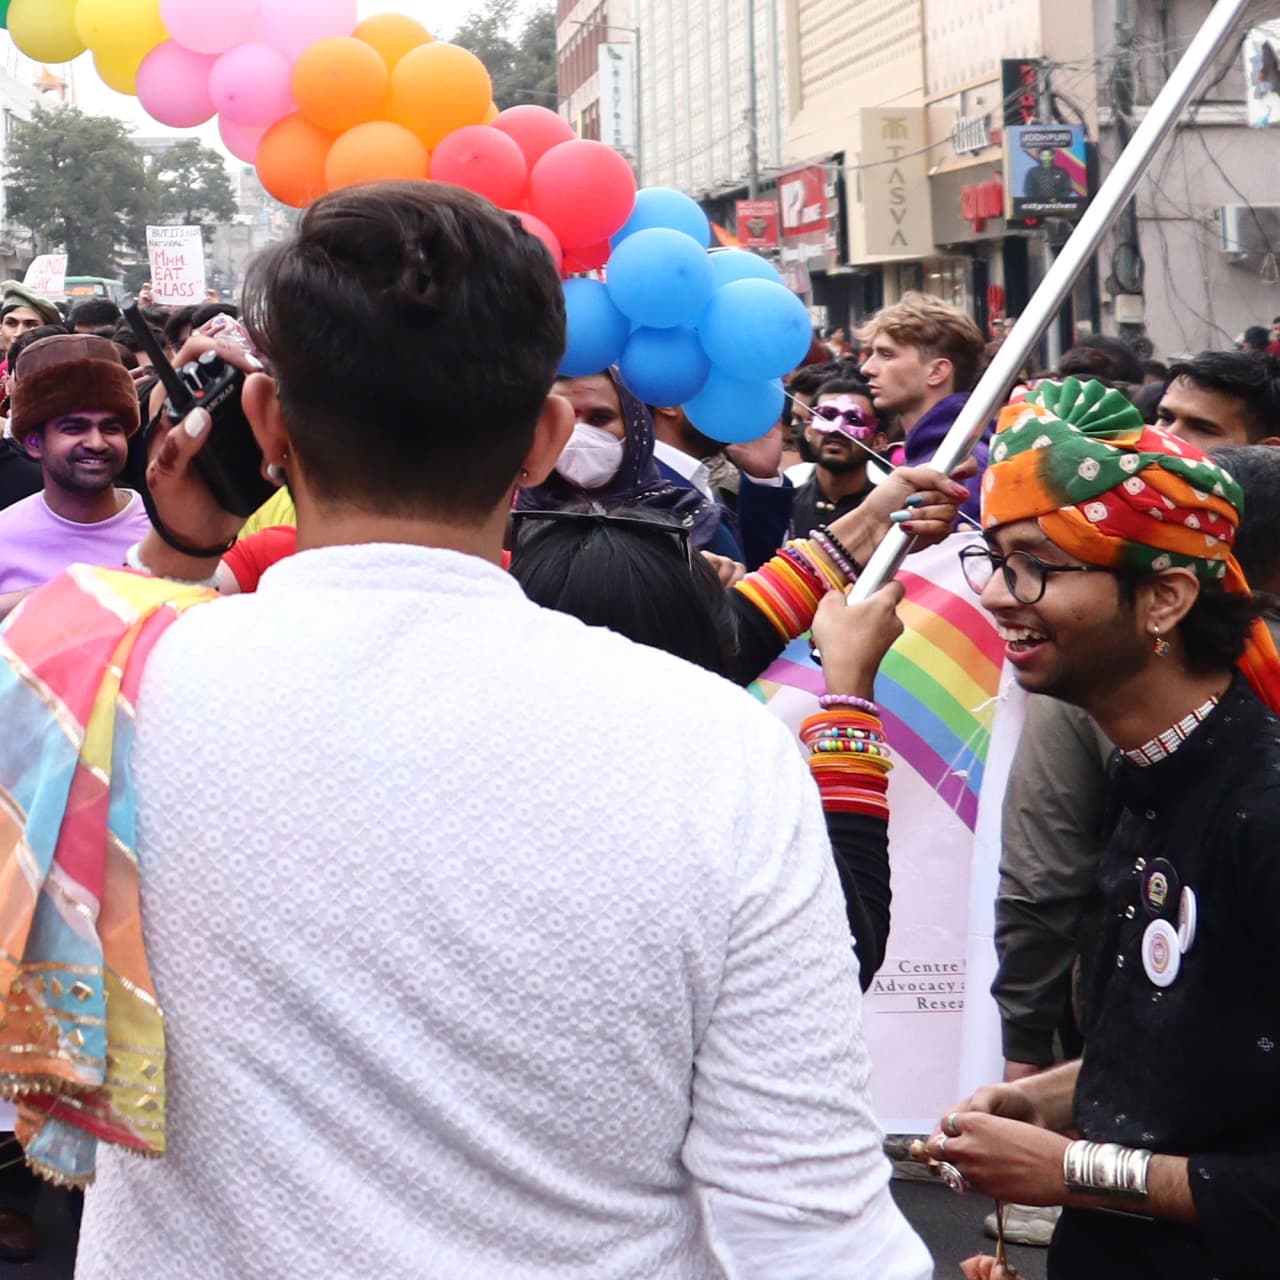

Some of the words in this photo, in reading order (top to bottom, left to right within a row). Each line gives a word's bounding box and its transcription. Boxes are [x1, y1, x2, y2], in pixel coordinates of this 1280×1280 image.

[886, 145, 909, 247] TASVA
[154, 266, 183, 281] EAT
[898, 960, 958, 973] Centre
[873, 978, 956, 994] Advocacy
